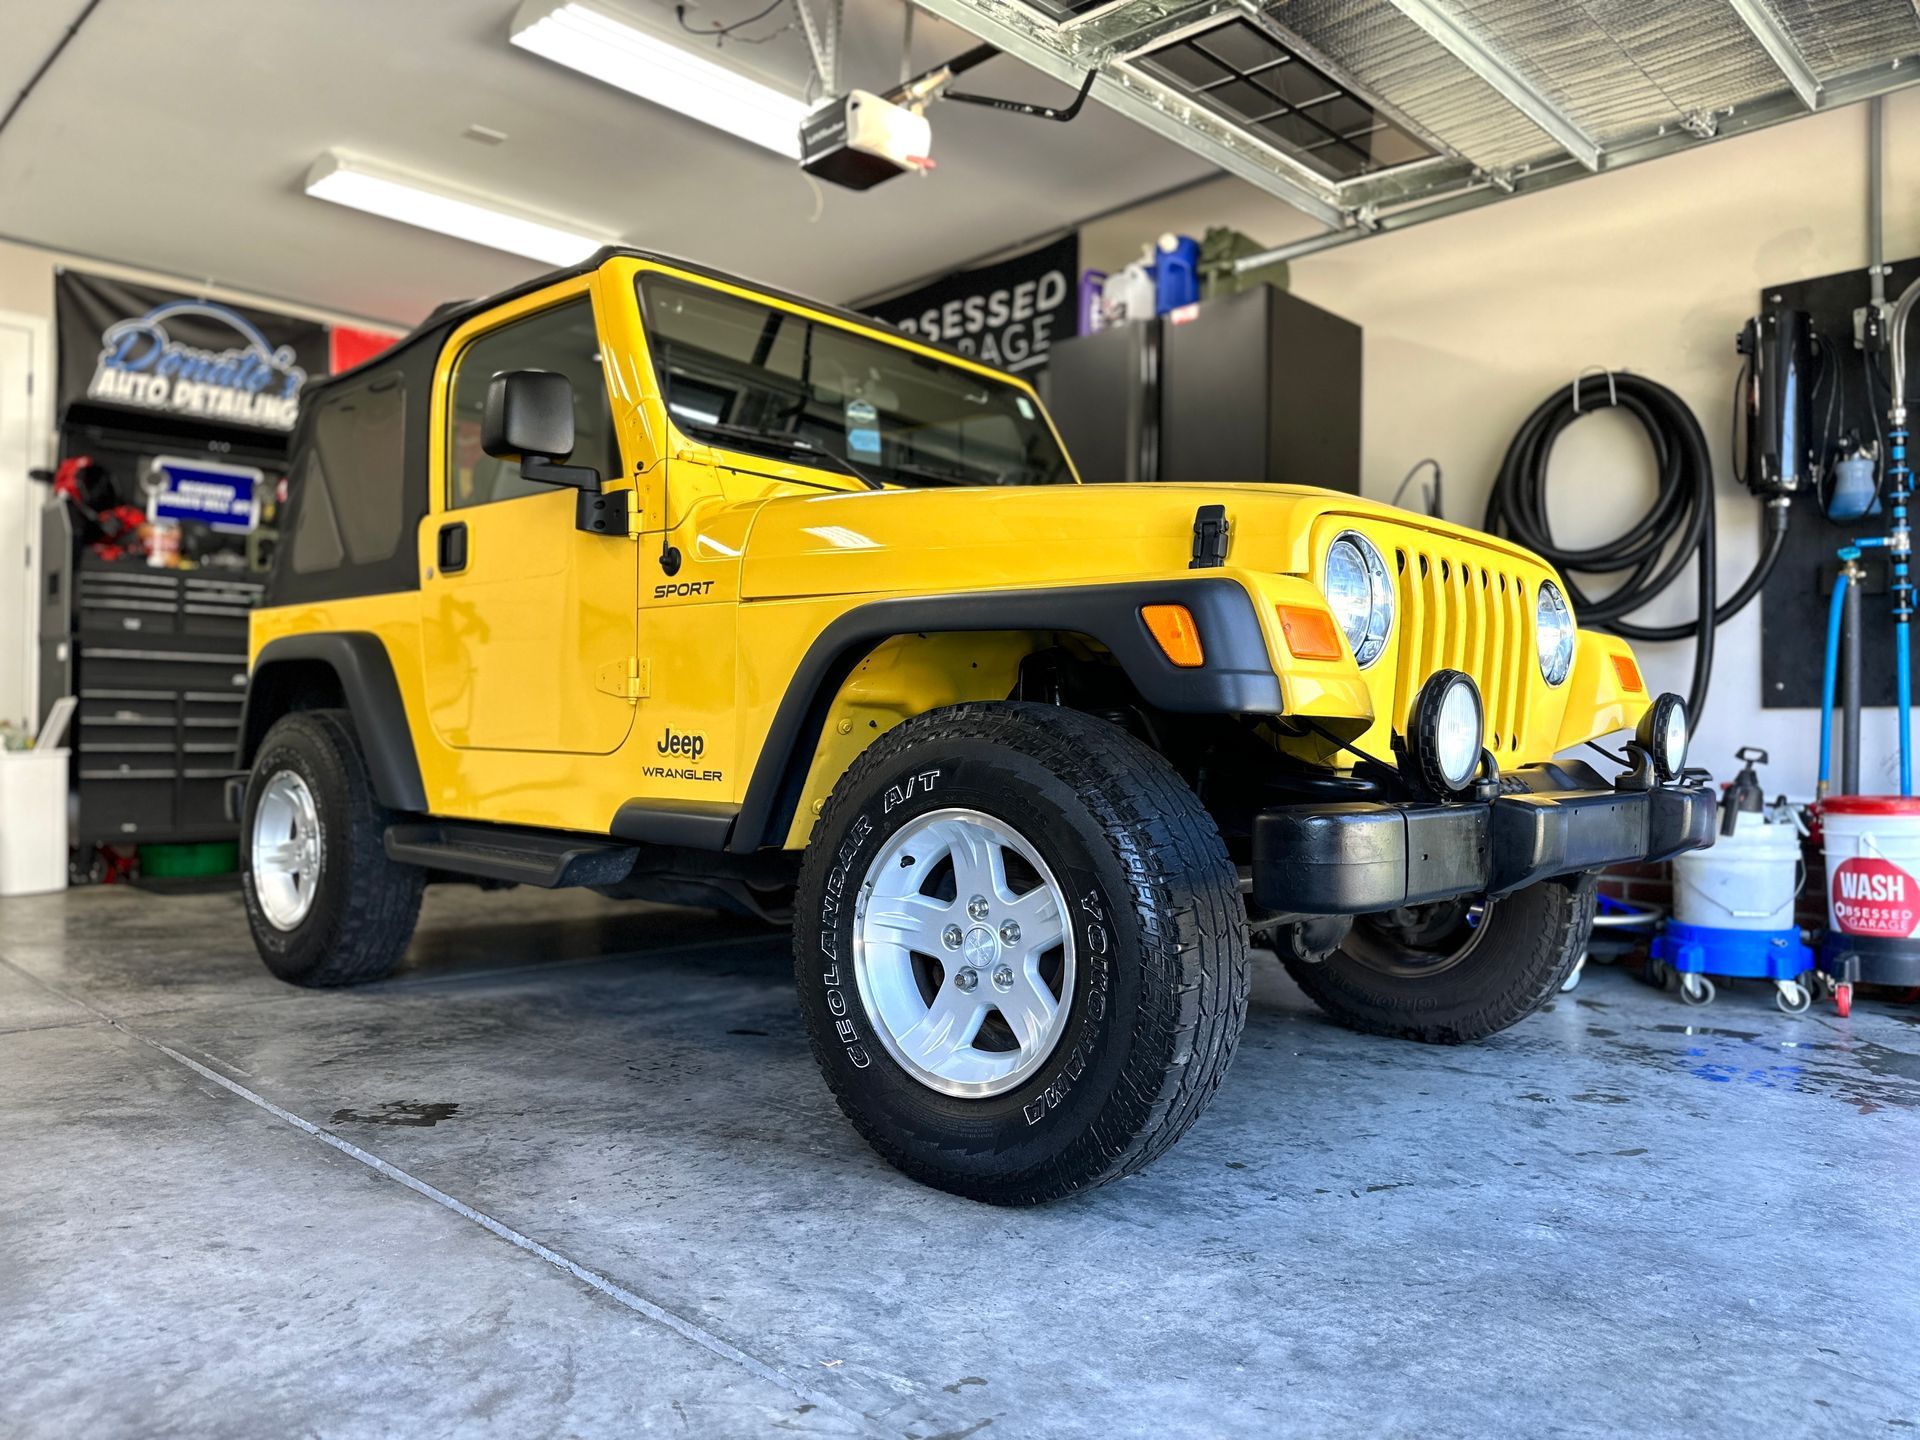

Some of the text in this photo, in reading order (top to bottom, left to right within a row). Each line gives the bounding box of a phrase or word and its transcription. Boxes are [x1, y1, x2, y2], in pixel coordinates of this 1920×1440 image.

[96, 366, 299, 430] AUTO DETAILING
[653, 580, 715, 599] SPORT
[657, 727, 704, 760] Jeep
[641, 766, 723, 782] WRANGLER
[1839, 871, 1905, 902] WASH
[821, 770, 941, 1069] GEOLANDAR A/T
[1834, 901, 1914, 920] OBSESSED
[1848, 916, 1909, 932] GARAGE
[1022, 888, 1109, 1126] YOKOHAMA
